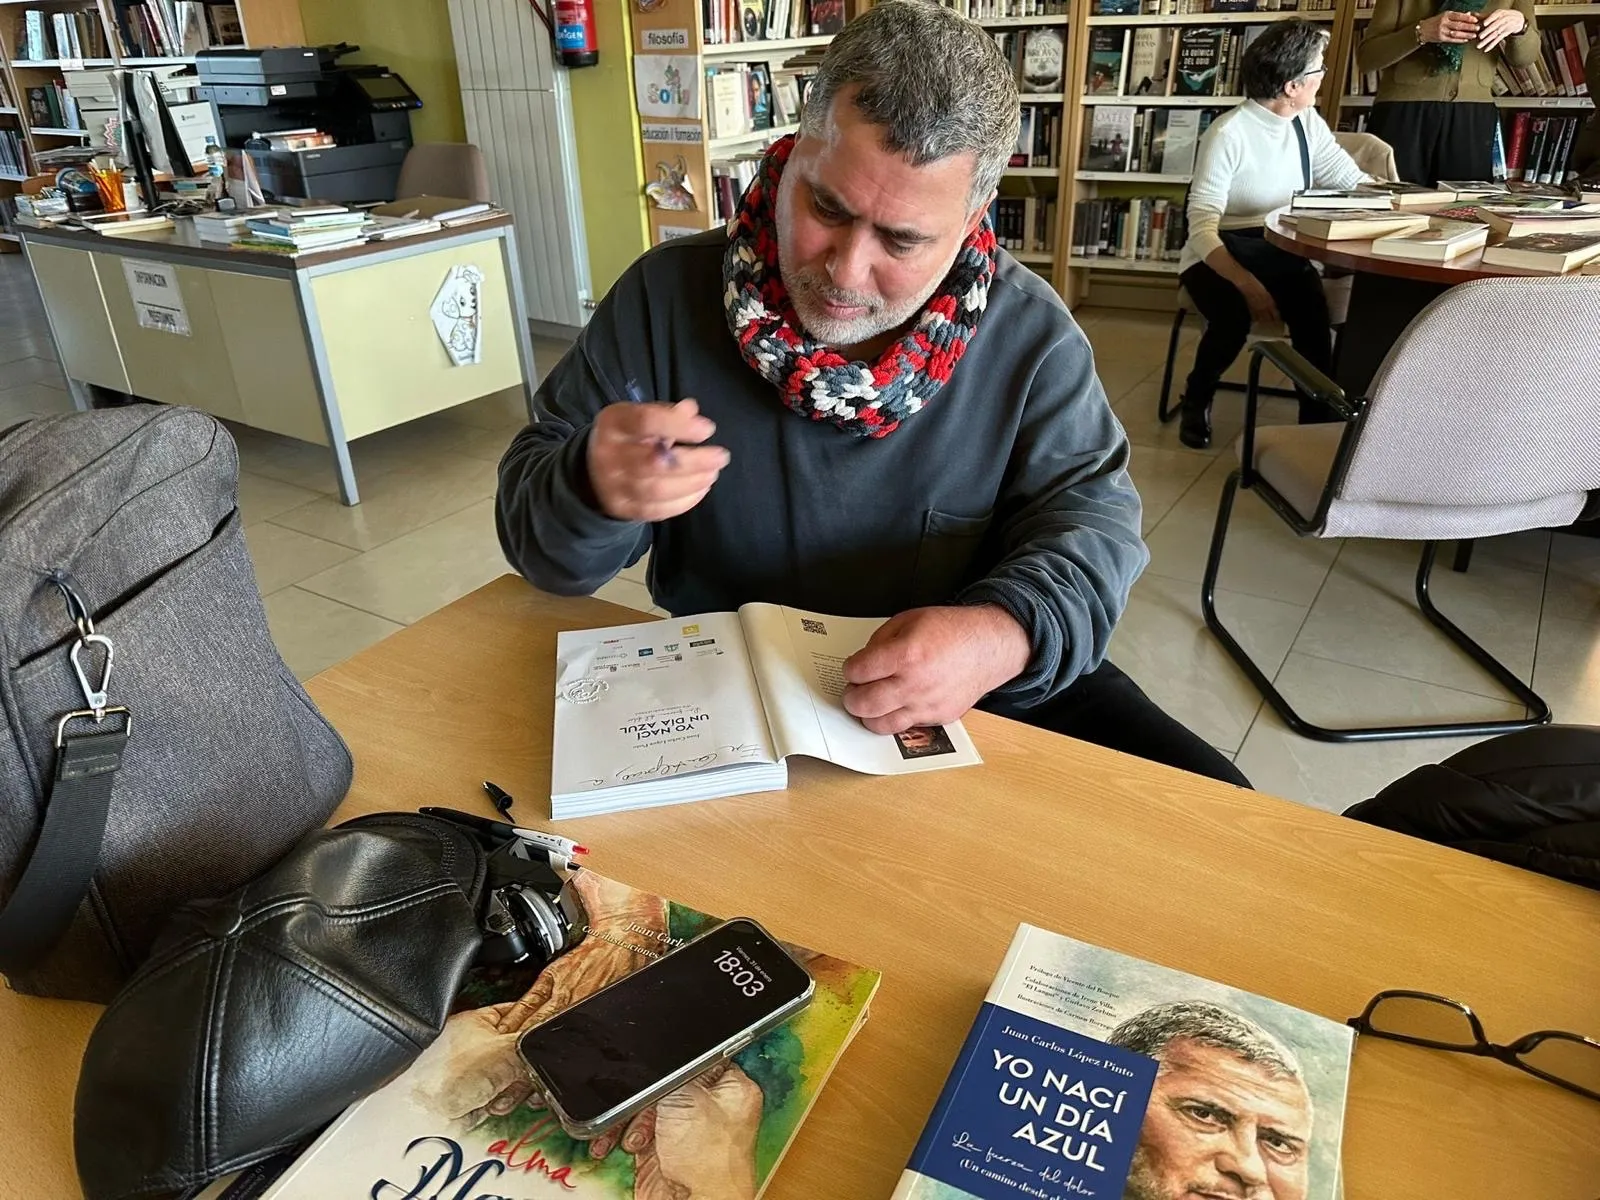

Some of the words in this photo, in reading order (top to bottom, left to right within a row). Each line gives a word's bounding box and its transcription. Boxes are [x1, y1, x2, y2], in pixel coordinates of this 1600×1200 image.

[647, 32, 685, 45] filosofía
[1181, 49, 1189, 57] LA
[1183, 57, 1194, 65] DEL
[660, 717, 685, 726] DÍA
[690, 713, 709, 722] UN
[620, 721, 657, 734] AZUL
[637, 727, 671, 740] NACÍ
[675, 723, 695, 732] YO
[624, 921, 655, 938] Juan
[581, 925, 601, 938] Con
[601, 931, 661, 959] ilustraciones
[713, 950, 765, 997] 18:03
[1025, 976, 1071, 995] Colaboraciones
[1063, 976, 1086, 987] Vicente
[1086, 983, 1096, 992] del
[1001, 1025, 1029, 1041] Juan
[1031, 1035, 1066, 1054] Carlos
[1067, 1047, 1101, 1067] López
[1103, 1059, 1135, 1078] Pinto
[993, 1048, 1034, 1079] YO
[1042, 1068, 1128, 1114] NACÍ
[998, 1081, 1047, 1116] UN
[1054, 1103, 1113, 1144] DÍA
[486, 1115, 577, 1190] alma
[1011, 1121, 1106, 1172] AZUL
[951, 1131, 983, 1153] La
[1038, 1166, 1062, 1184] del
[1063, 1175, 1097, 1198] dolor
[959, 1158, 979, 1173] (Un
[980, 1167, 1018, 1188] camino
[1018, 1181, 1049, 1199] desde
